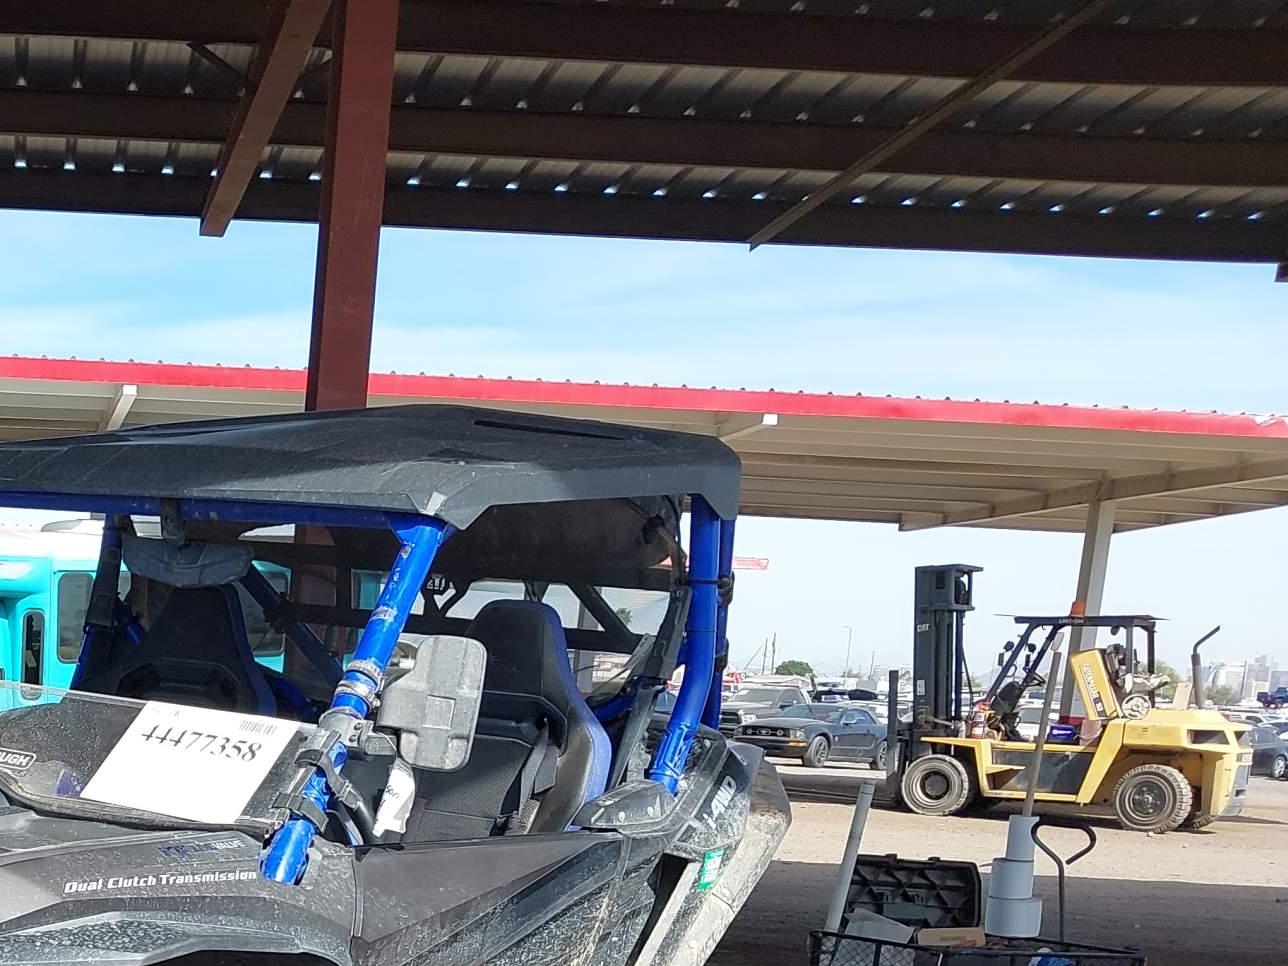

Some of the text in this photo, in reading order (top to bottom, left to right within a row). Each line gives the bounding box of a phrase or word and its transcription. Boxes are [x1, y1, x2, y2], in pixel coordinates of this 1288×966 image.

[141, 724, 262, 761] 44477358
[63, 869, 258, 894] Dual Clutch Transmission
